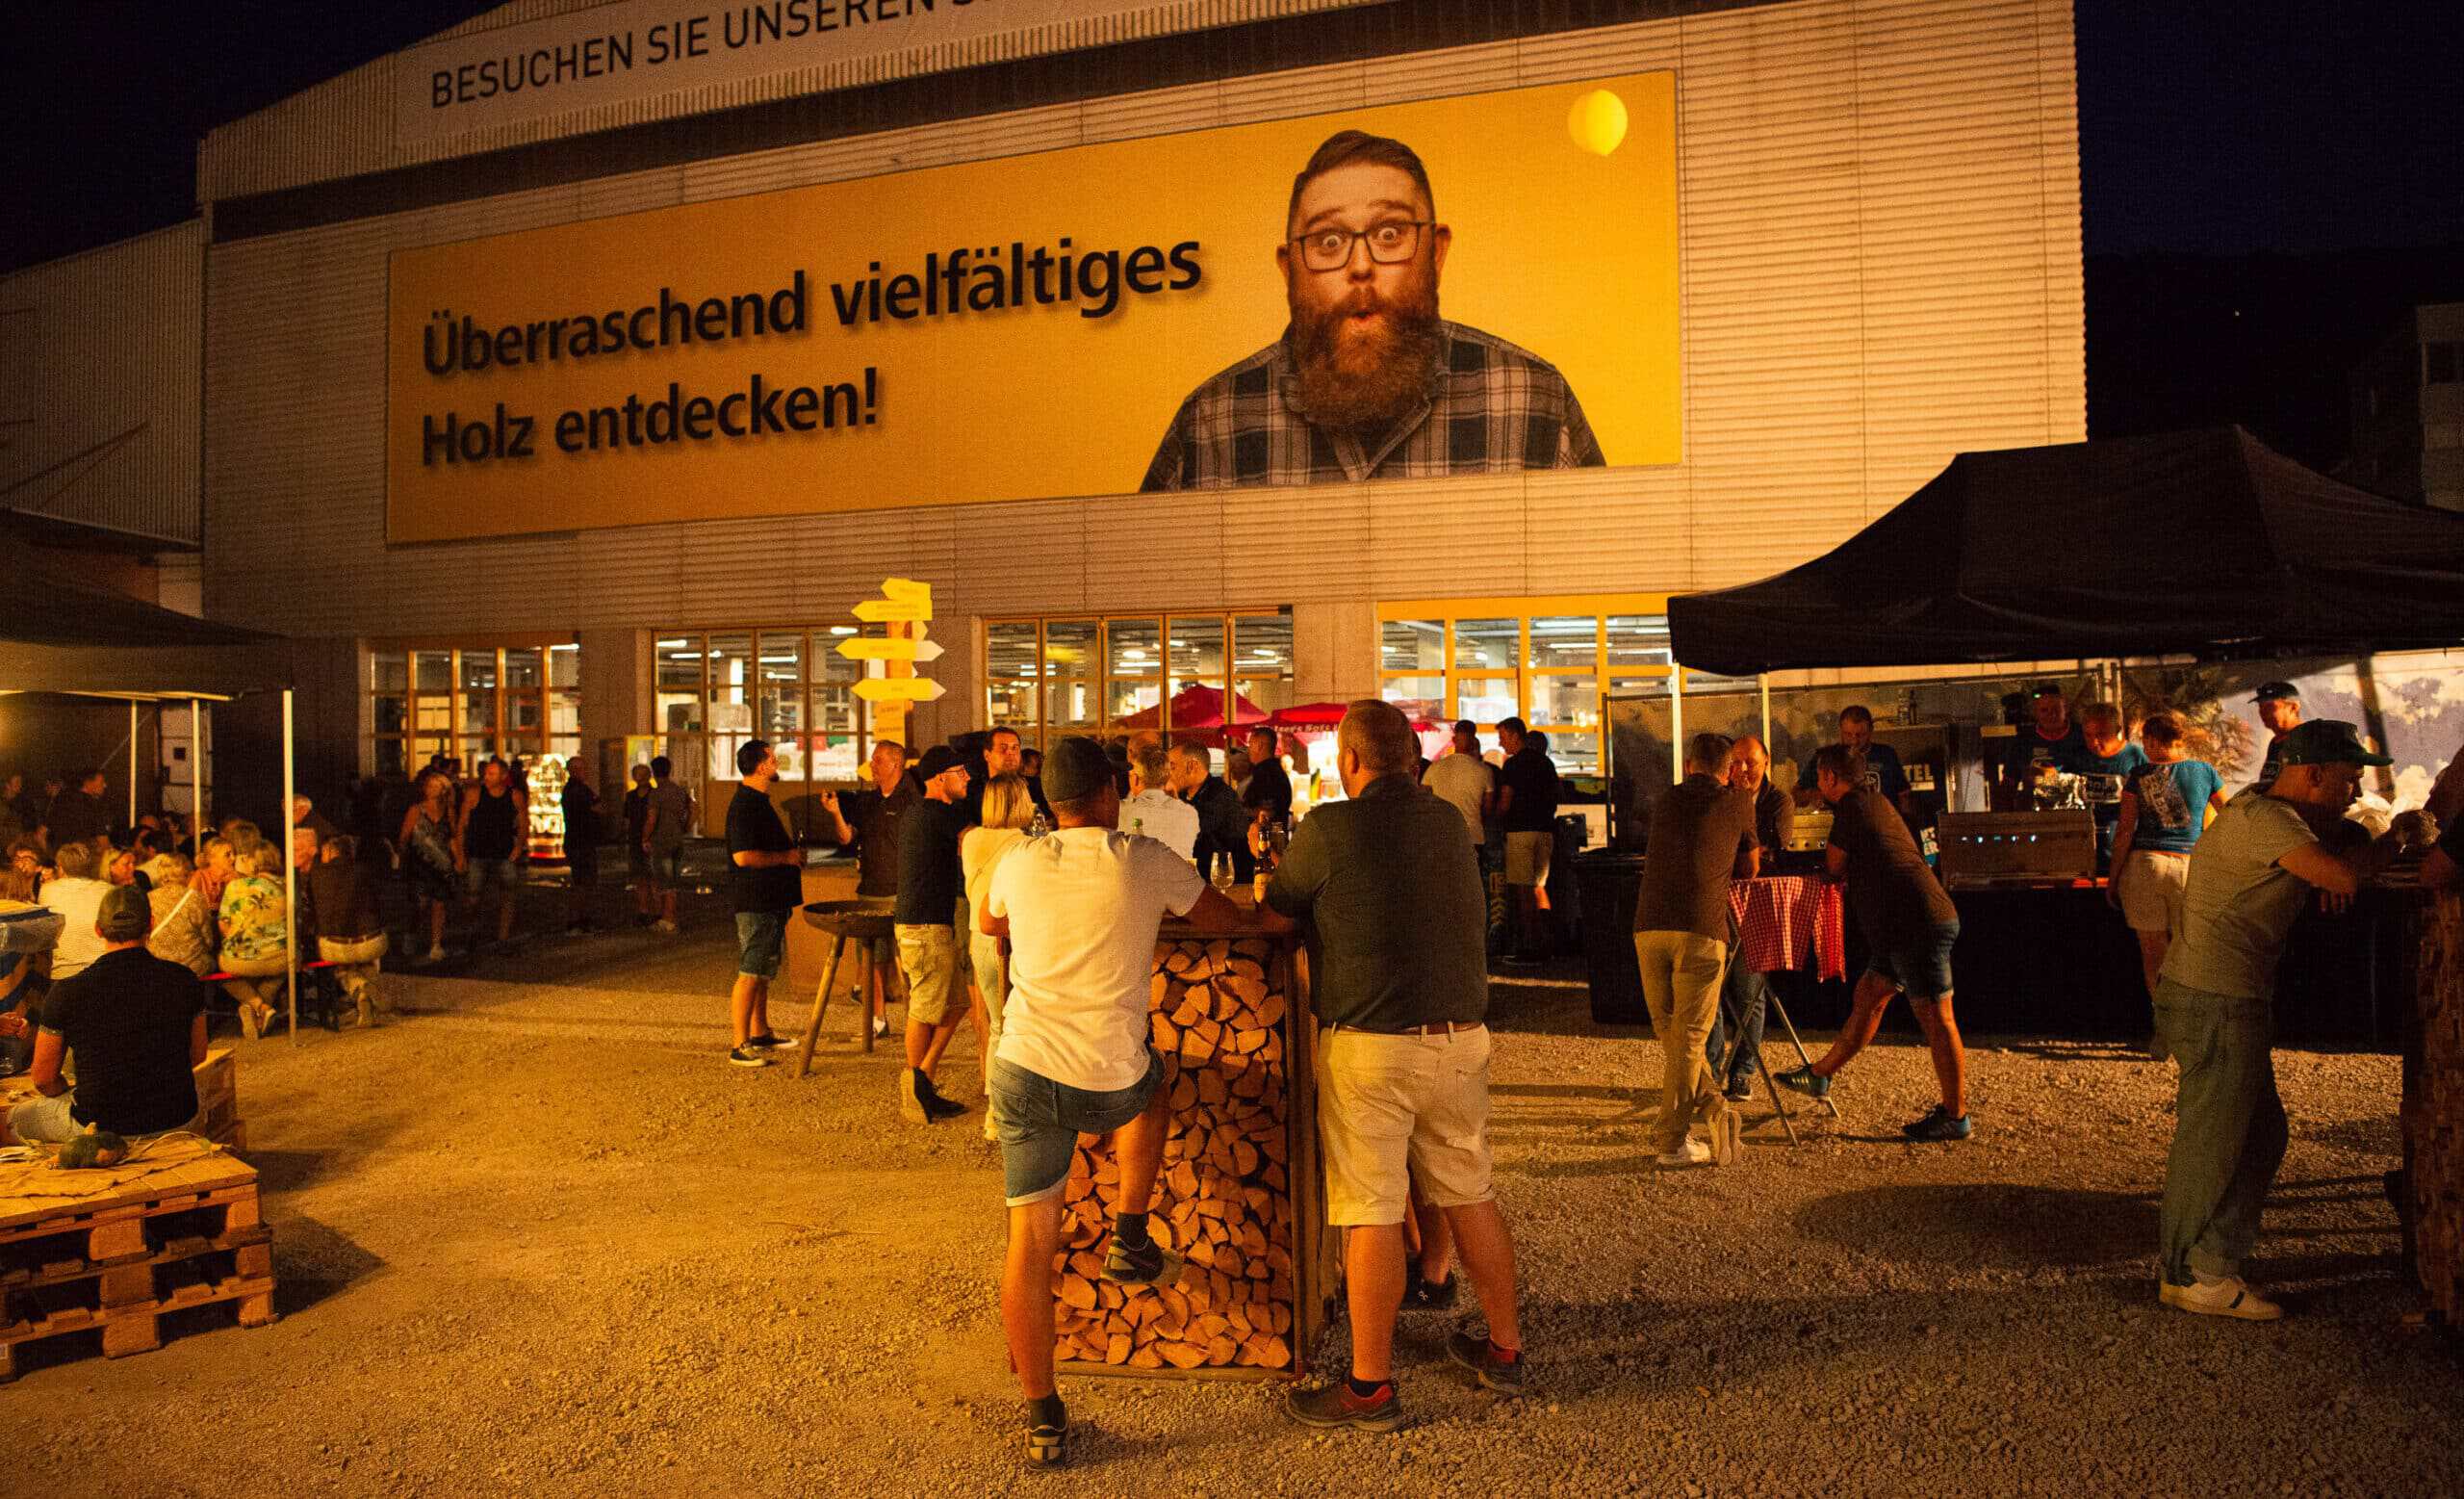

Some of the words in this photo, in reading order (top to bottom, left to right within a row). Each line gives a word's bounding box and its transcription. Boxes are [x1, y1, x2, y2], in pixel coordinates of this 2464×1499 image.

[431, 32, 632, 109] BESUCHEN
[648, 16, 708, 64] SIE
[424, 270, 806, 376] Überraschend
[832, 238, 1200, 325] vielfältiges
[423, 402, 534, 467] Holz
[554, 367, 878, 453] entdecken!
